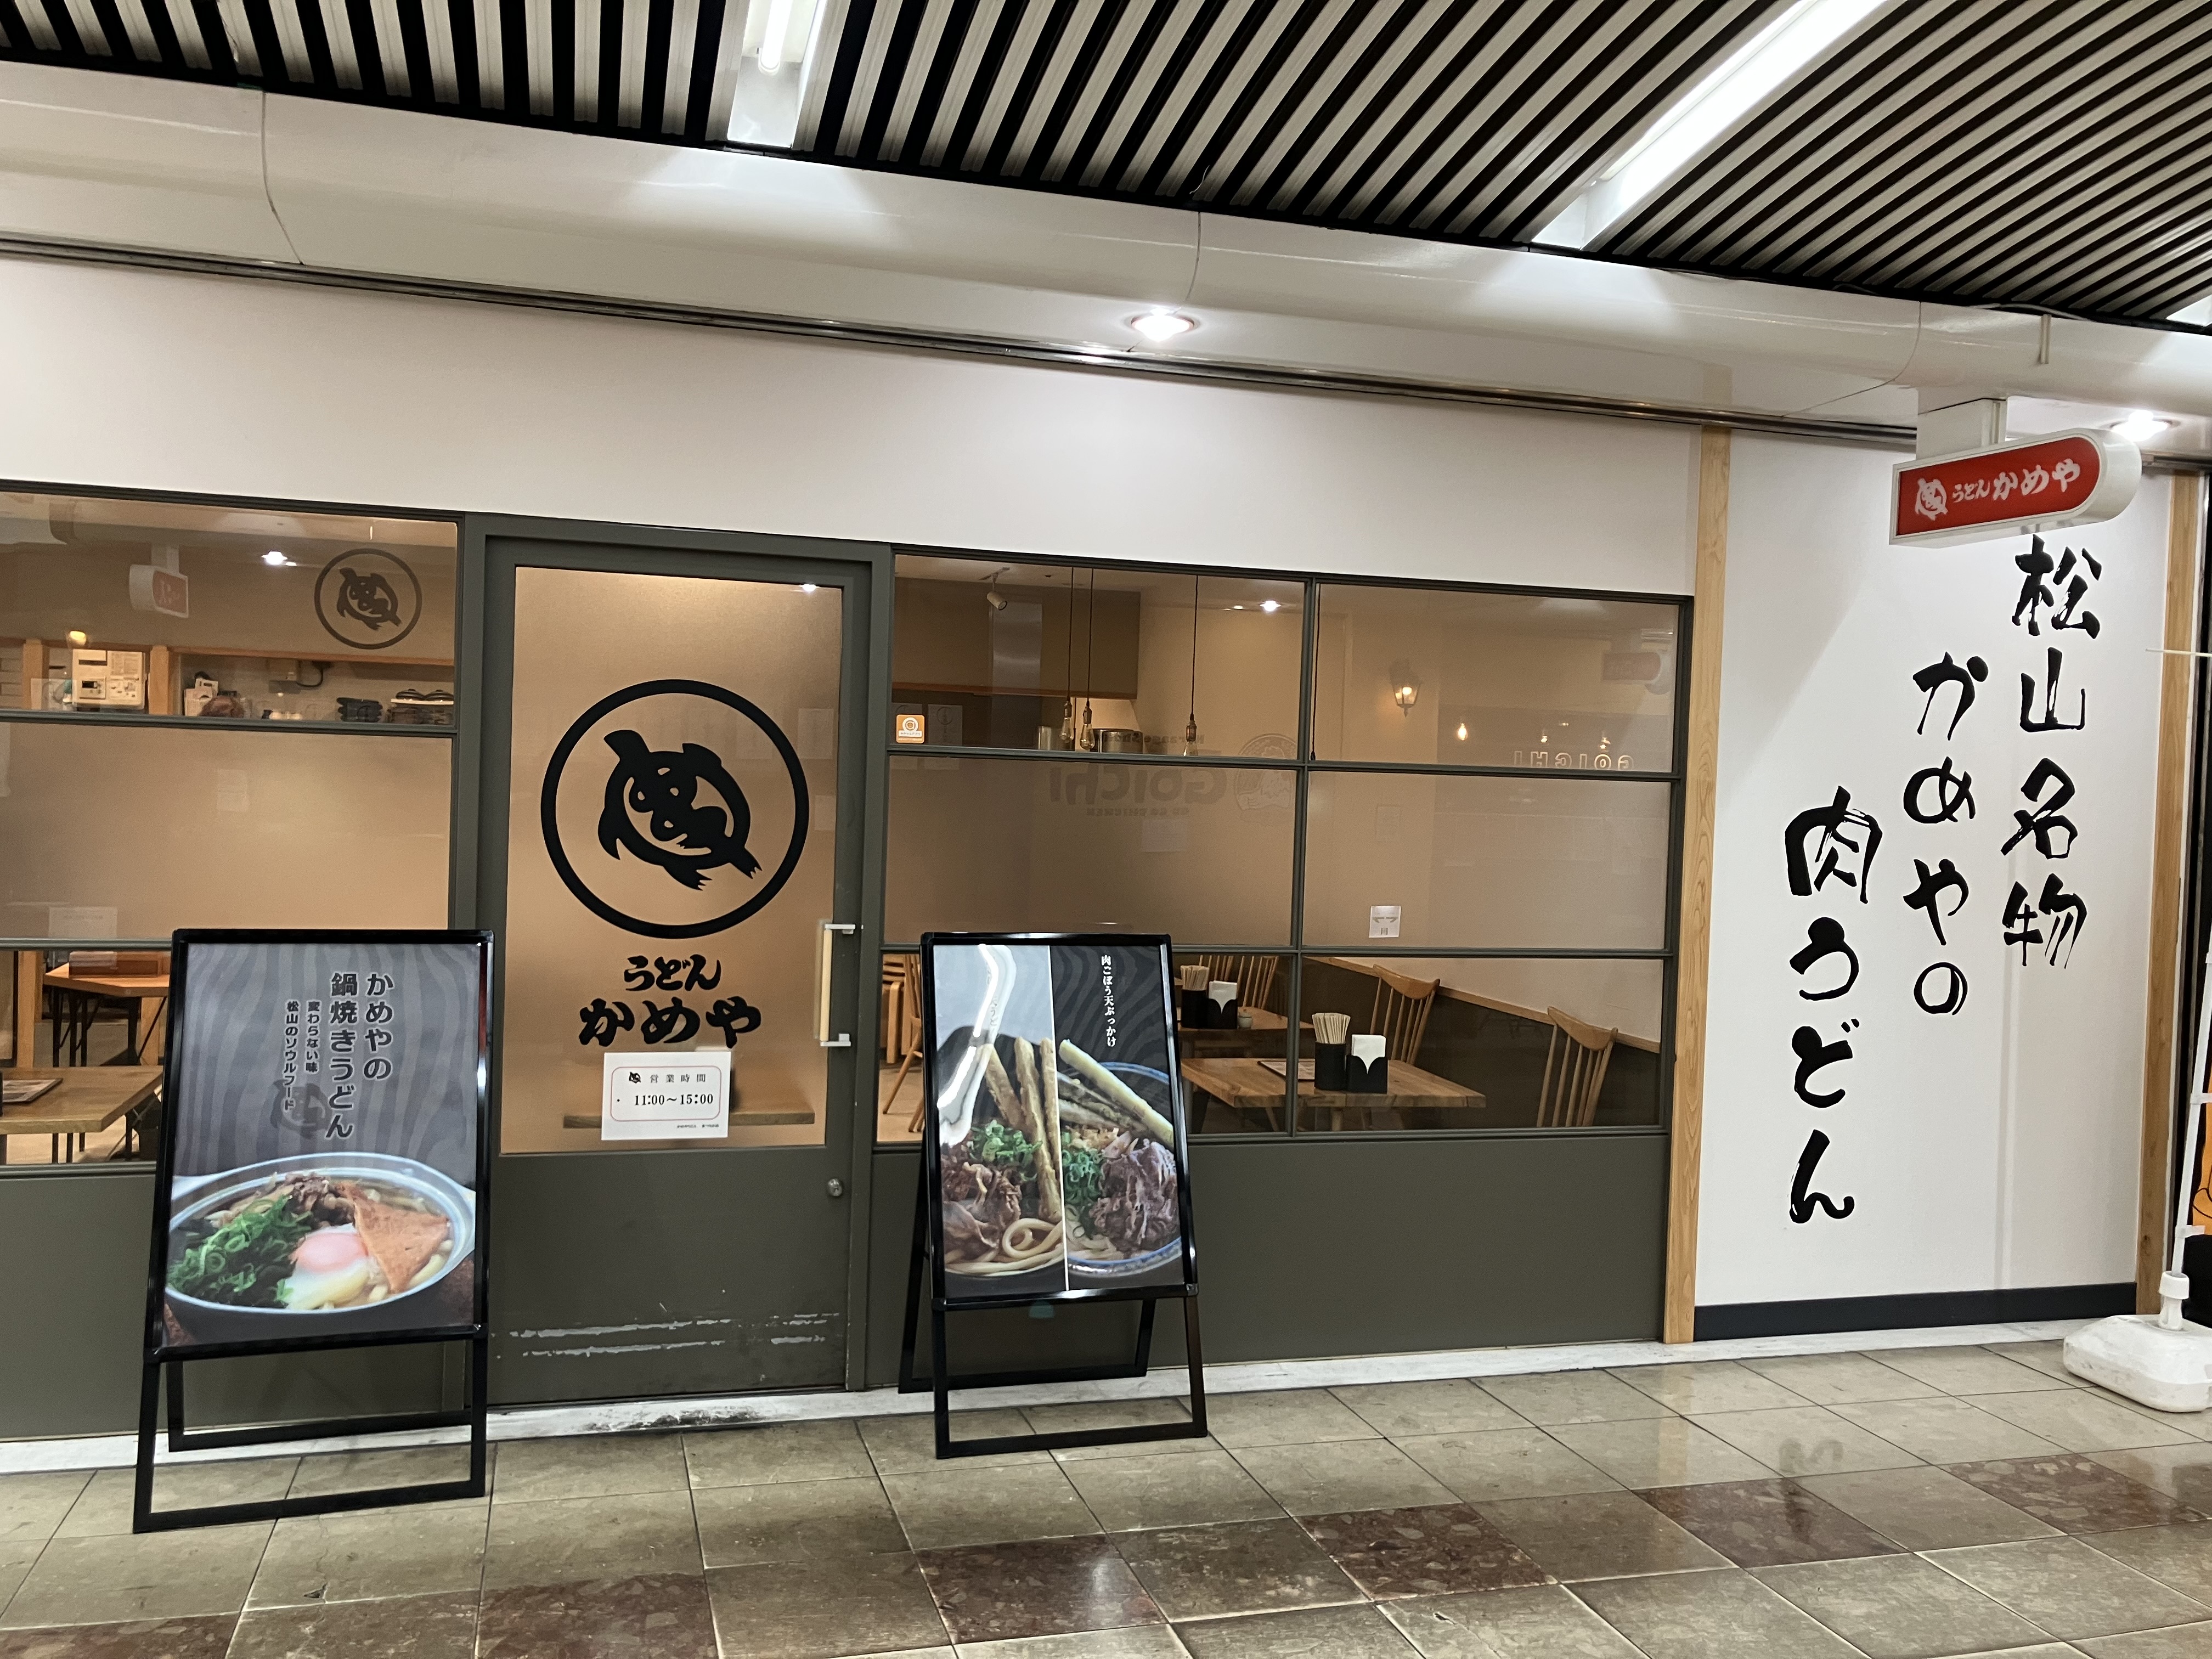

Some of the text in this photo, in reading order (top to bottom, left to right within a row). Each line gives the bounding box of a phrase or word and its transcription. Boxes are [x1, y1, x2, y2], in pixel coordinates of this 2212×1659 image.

[2001, 534, 2101, 969] 松山名物
[1903, 651, 1988, 1015] かめやの
[363, 973, 394, 1080] かめやの
[578, 996, 761, 1049] かめや
[624, 954, 721, 992] うどん
[1785, 786, 1883, 1224] 肉うどん
[283, 1000, 300, 1111] 松山のソウルフード
[306, 1001, 320, 1073] 変わらない味
[325, 972, 358, 1138] 鍋焼きうどん
[650, 1073, 706, 1084] 営業時間
